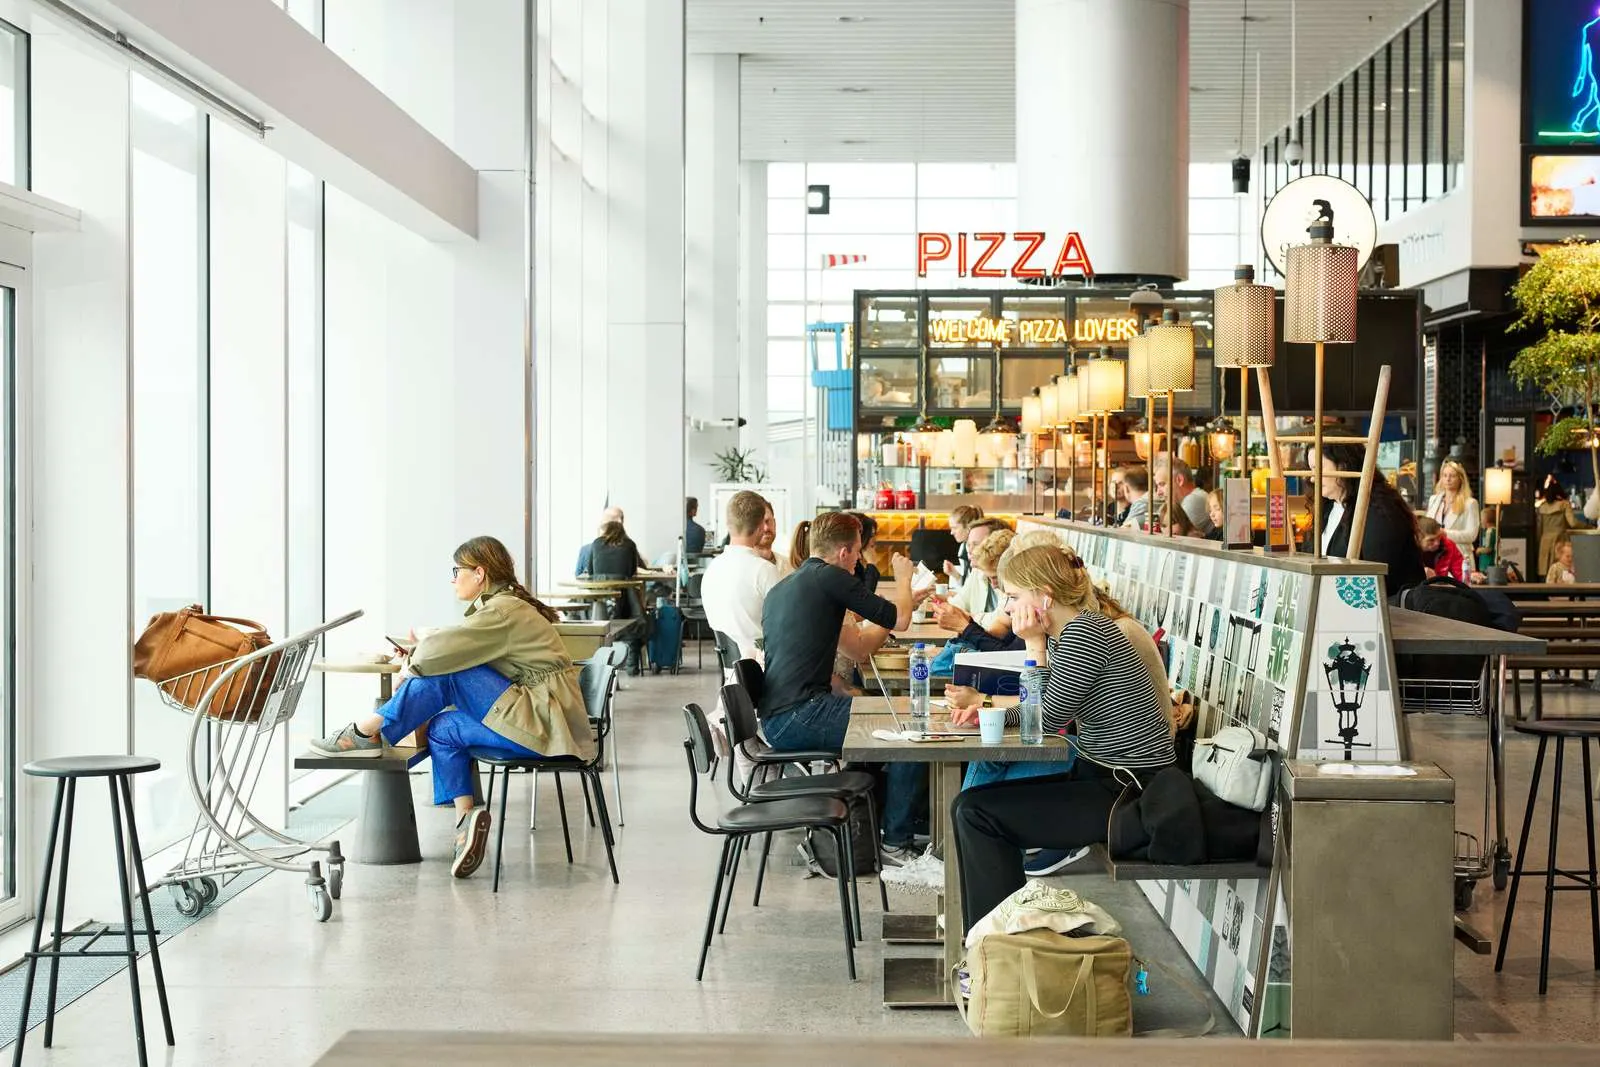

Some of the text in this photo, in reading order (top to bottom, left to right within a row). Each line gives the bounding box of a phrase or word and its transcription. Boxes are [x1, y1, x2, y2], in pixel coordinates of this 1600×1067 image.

[918, 232, 1095, 278] PIZZA
[931, 317, 1138, 343] WELCOME PIZZA LOVERS
